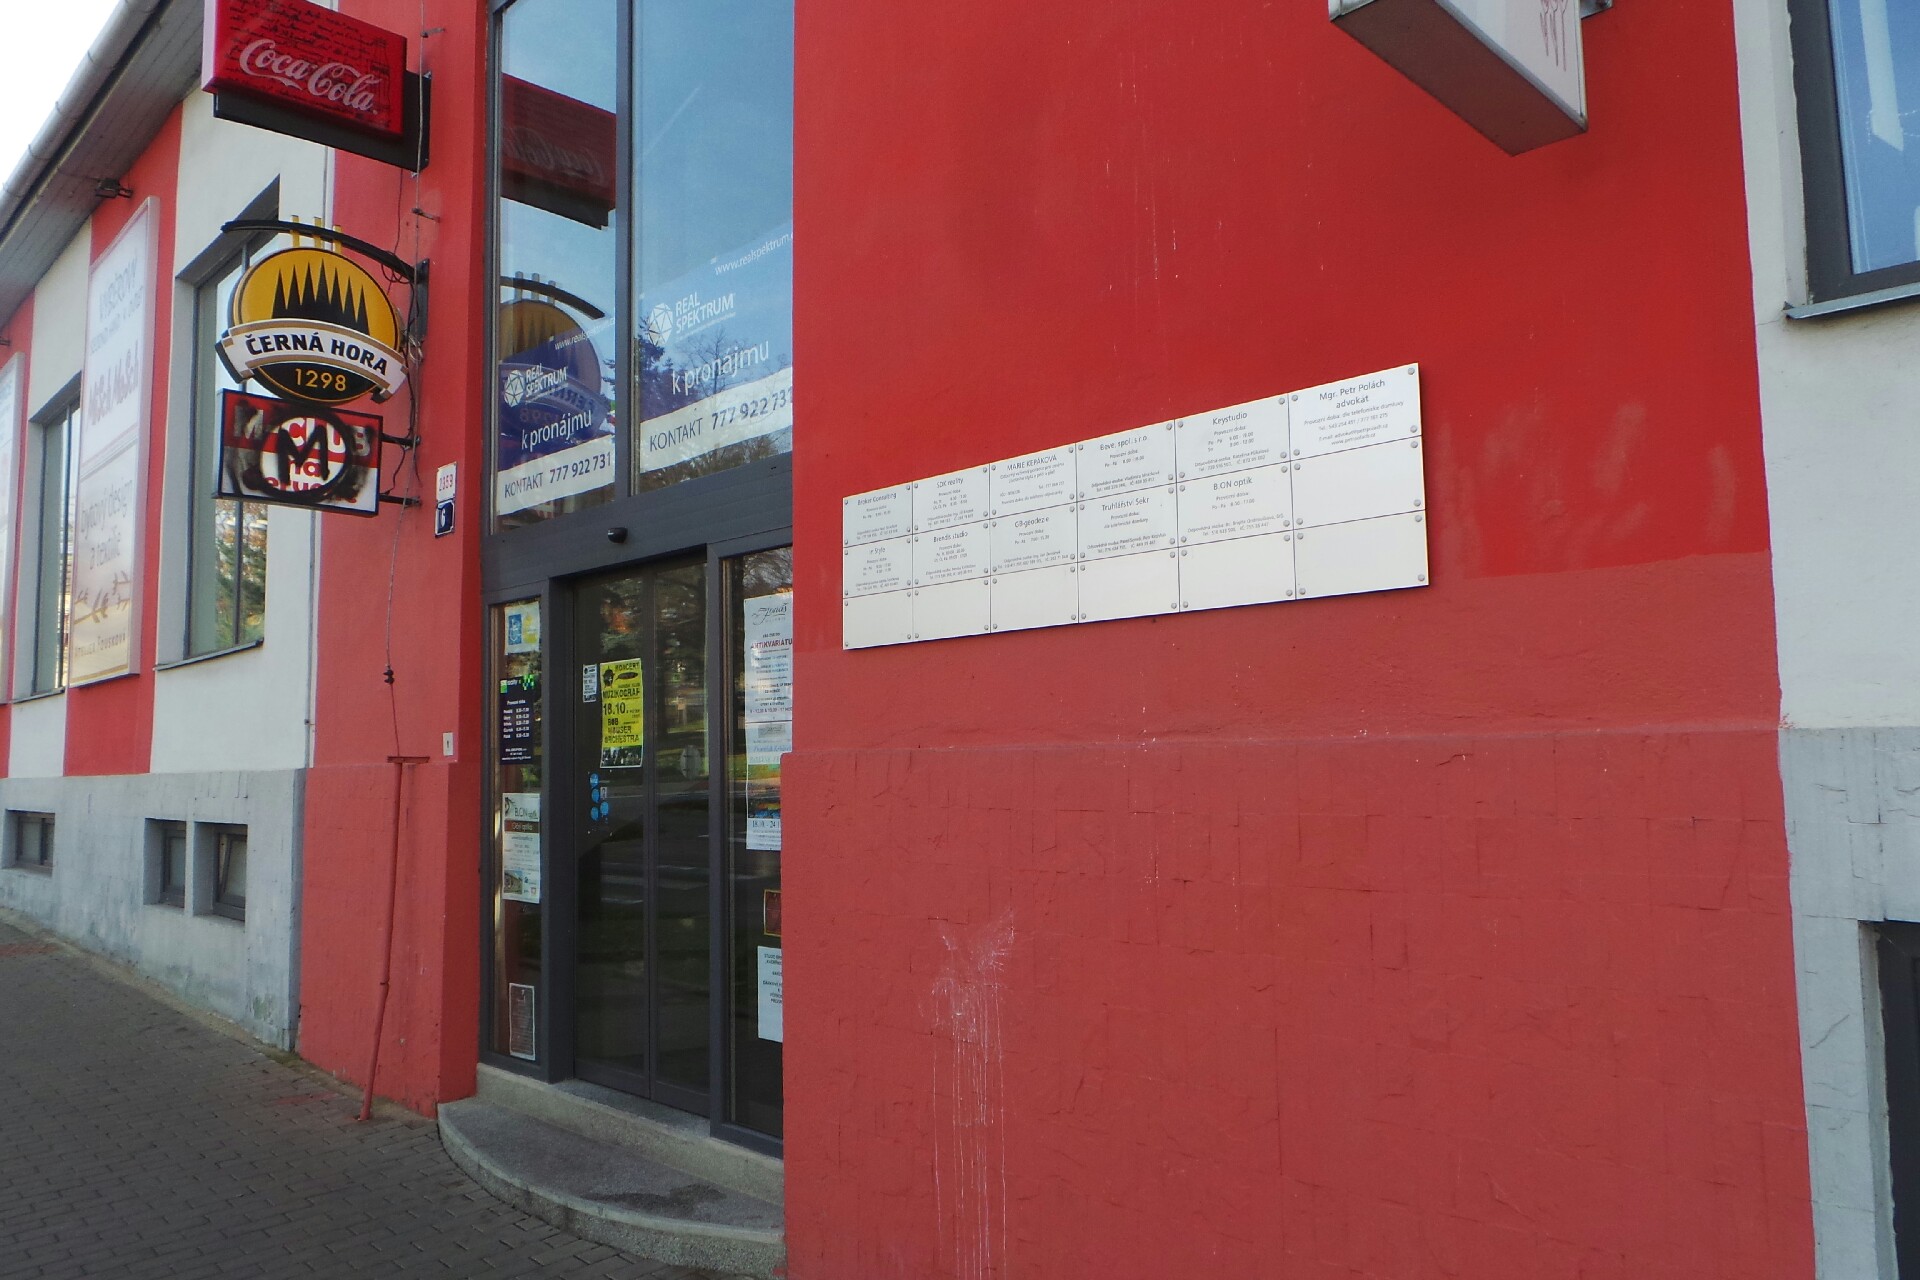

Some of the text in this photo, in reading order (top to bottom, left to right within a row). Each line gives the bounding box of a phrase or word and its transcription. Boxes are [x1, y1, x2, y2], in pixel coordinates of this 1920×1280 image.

[676, 292, 701, 317] REAL
[676, 293, 734, 334] SPEKTRUM
[245, 332, 388, 376] ČERNÁ HORA
[672, 341, 770, 396] k pronájmu
[295, 368, 347, 391] 1298
[526, 362, 543, 384] REAL
[526, 368, 568, 397] SPEKTRUM
[1319, 379, 1386, 402] Mgr. Petr Polách
[521, 409, 592, 452] k pronájmu
[650, 417, 703, 451] KONTAKT
[711, 406, 736, 430] 777
[740, 398, 768, 417] 922
[1212, 412, 1248, 425] Keystudio
[504, 451, 612, 498] KONTAKT 777 922 731
[1232, 477, 1253, 488] optik
